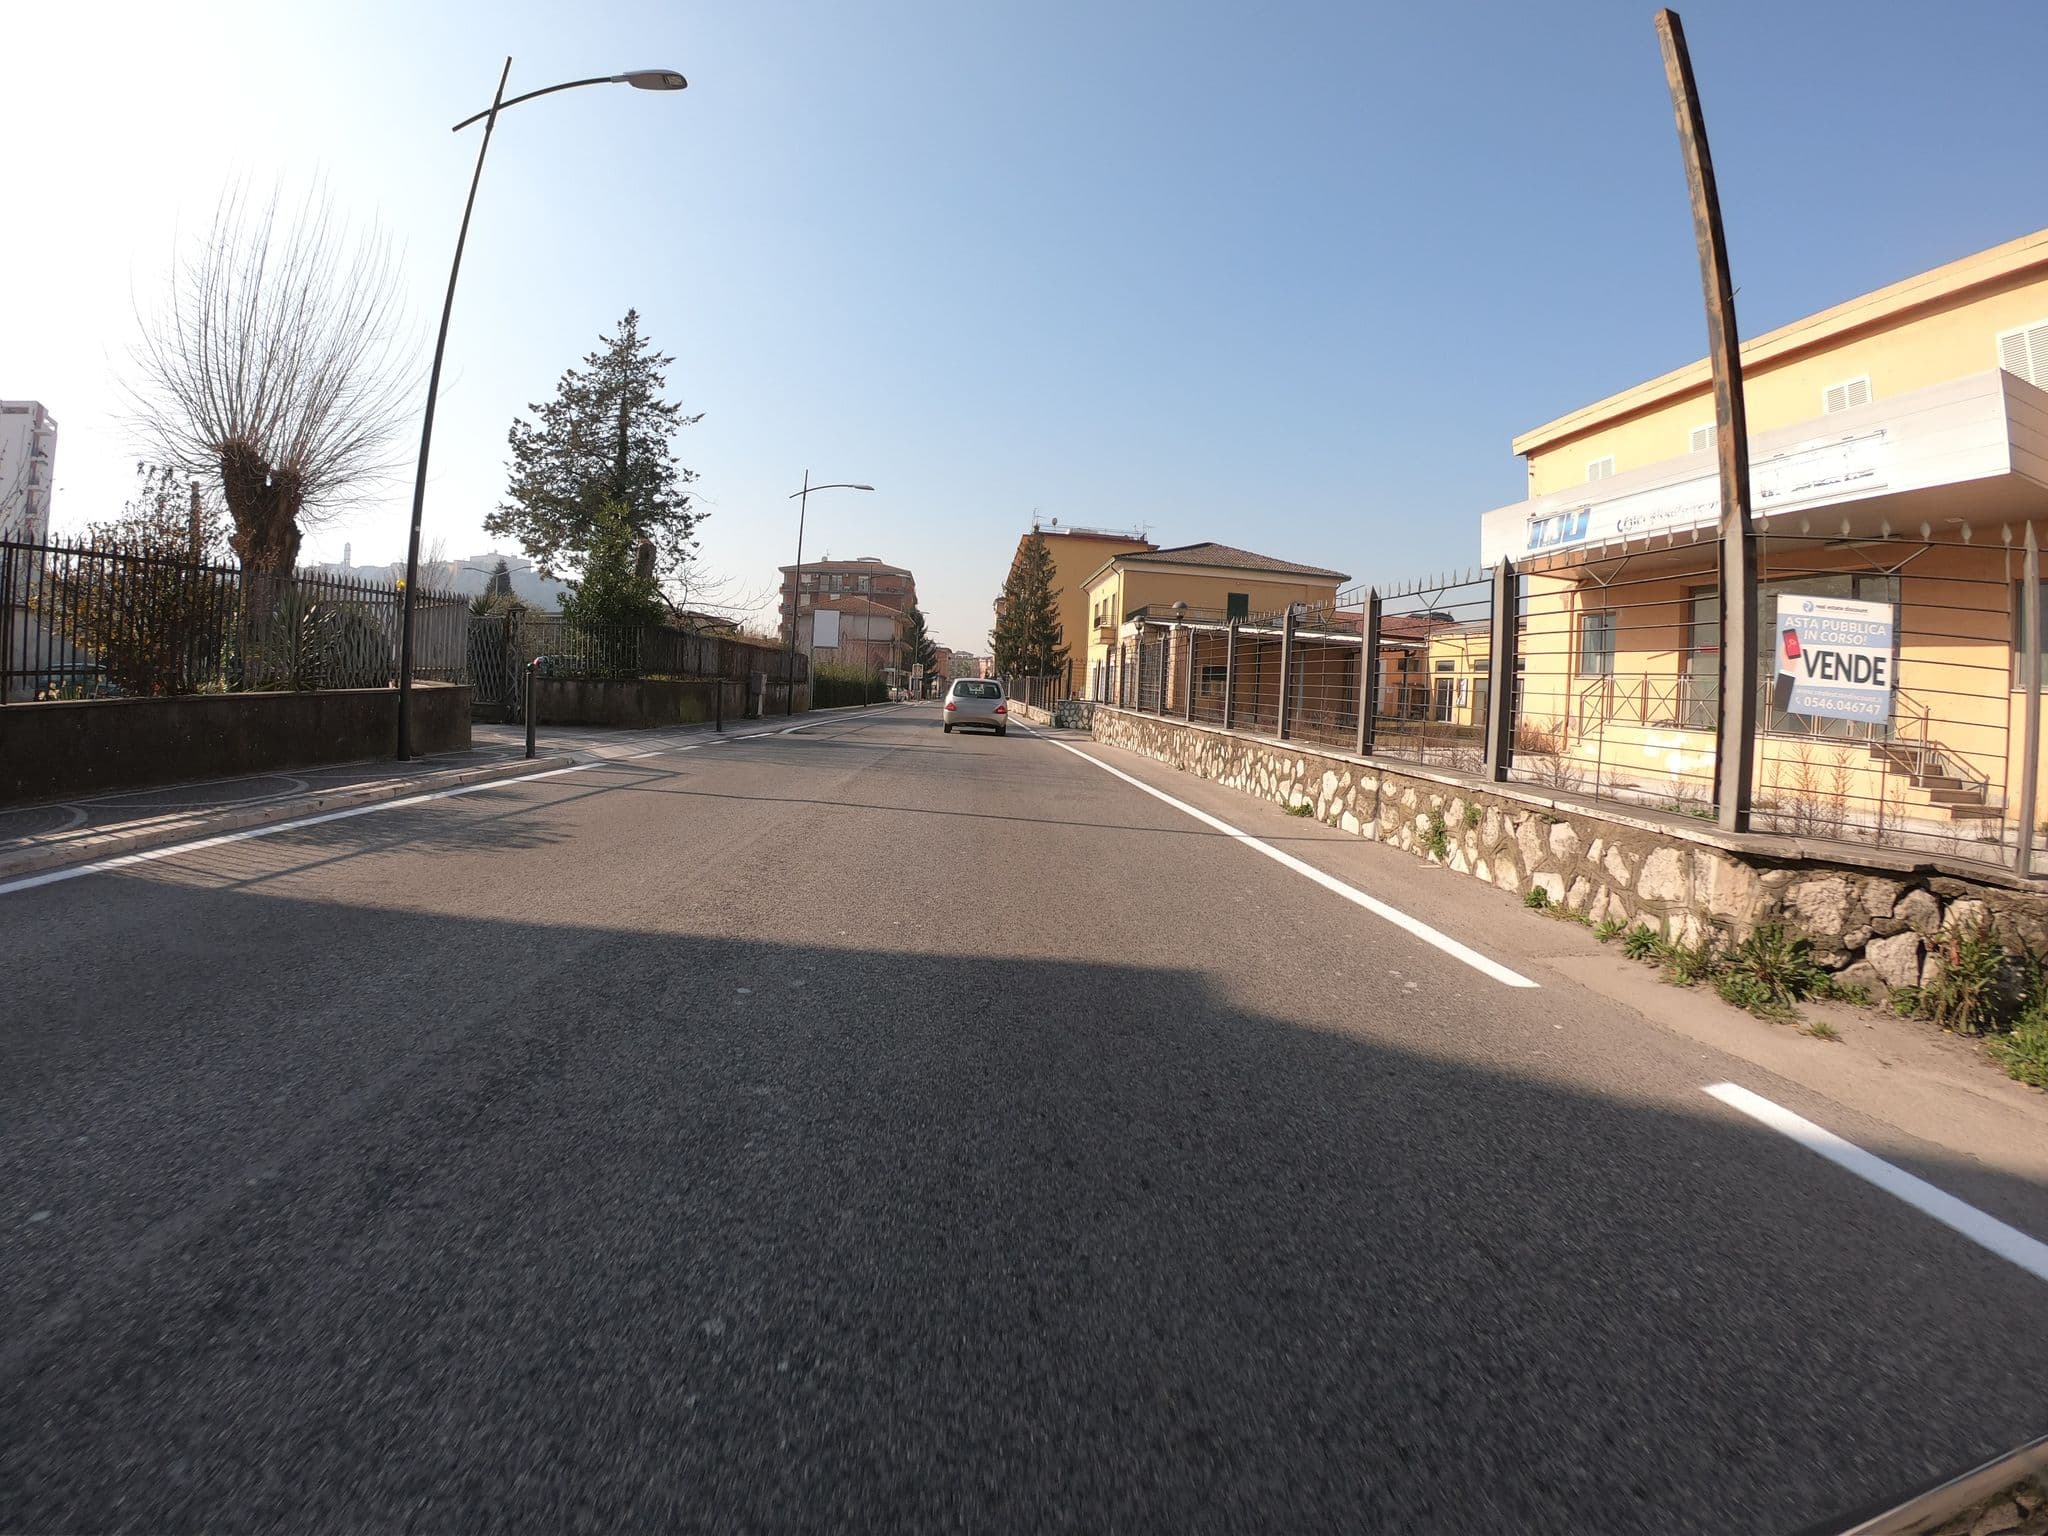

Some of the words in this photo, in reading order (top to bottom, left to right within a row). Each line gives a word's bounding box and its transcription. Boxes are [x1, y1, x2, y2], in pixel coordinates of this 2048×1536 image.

[1785, 616, 1819, 628] ASTA
[1822, 620, 1887, 635] PUBBLICA
[1804, 630, 1818, 640] IN
[1820, 631, 1868, 645] CORSO!
[1802, 648, 1886, 686] VENDE
[1804, 697, 1881, 716] 0546.046747
